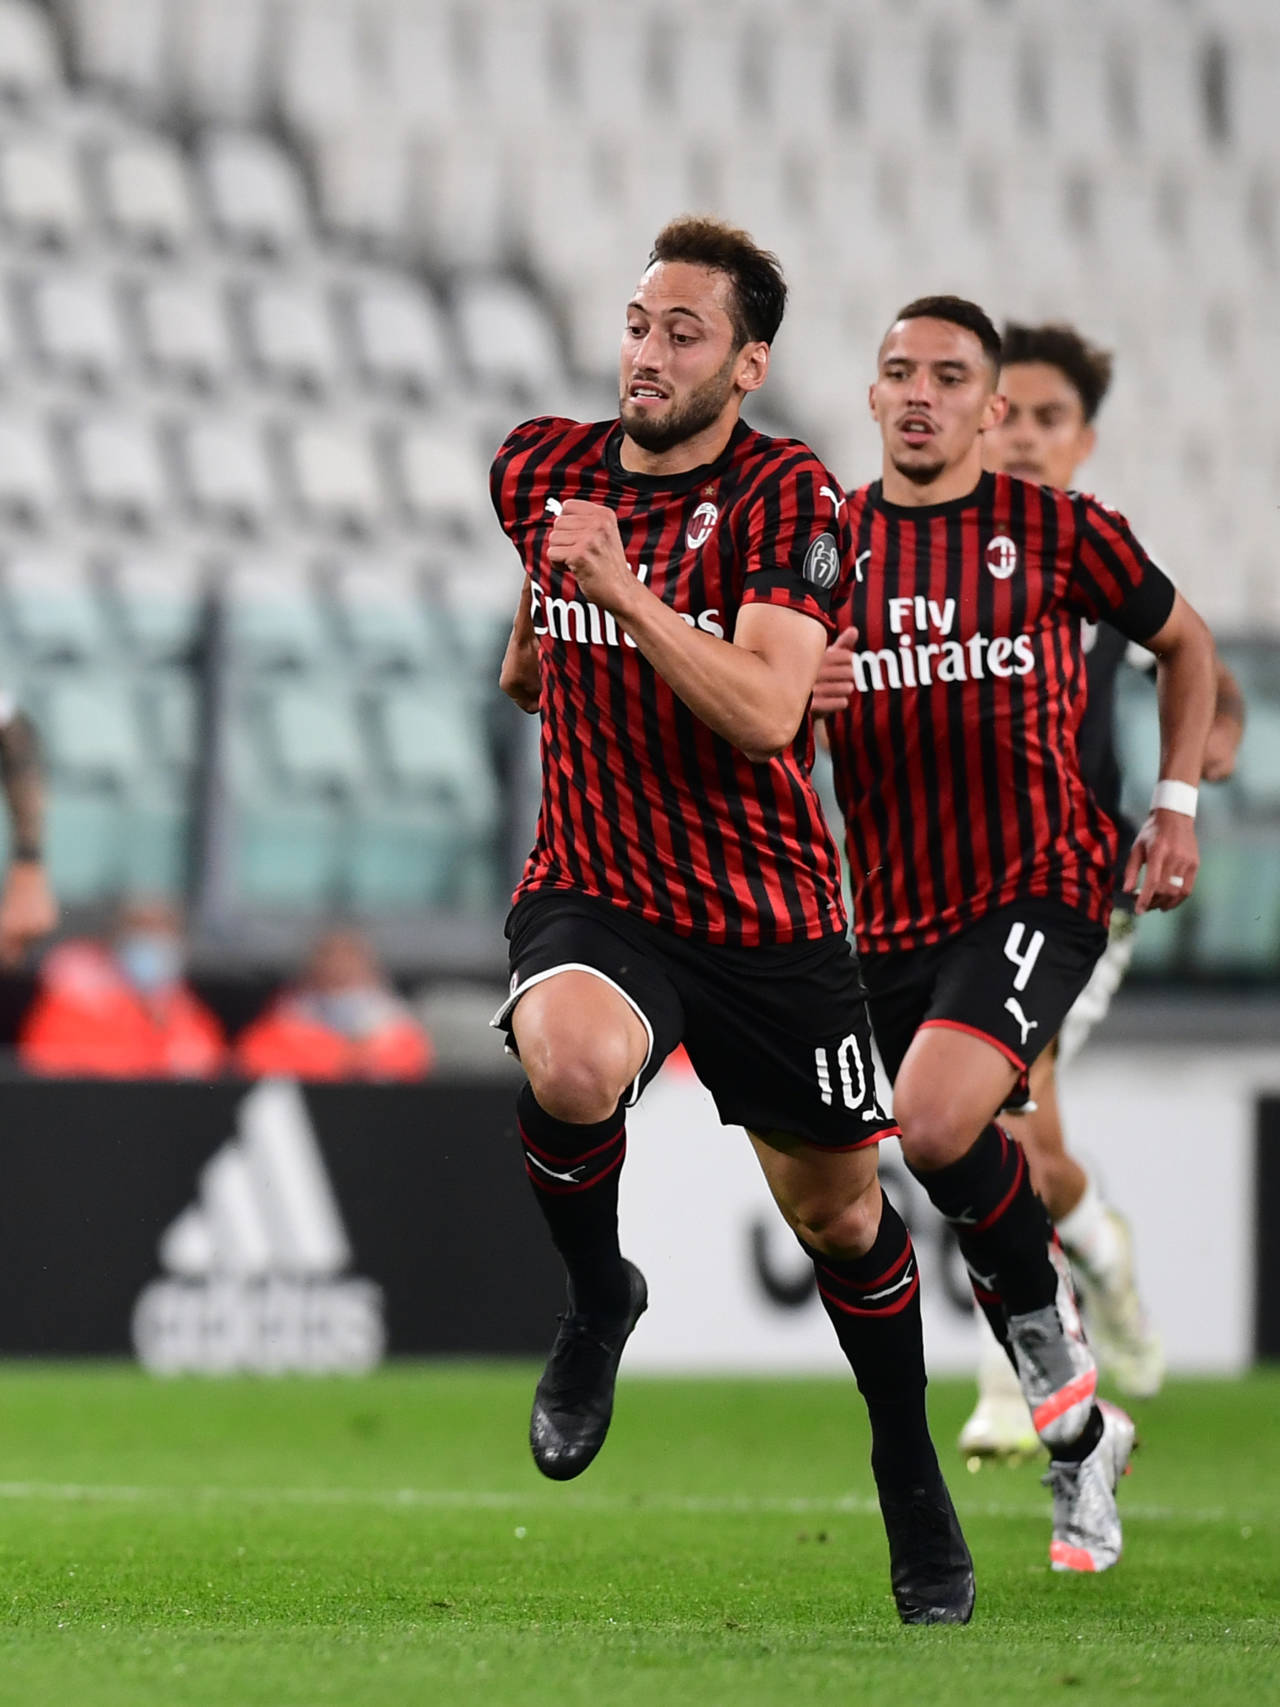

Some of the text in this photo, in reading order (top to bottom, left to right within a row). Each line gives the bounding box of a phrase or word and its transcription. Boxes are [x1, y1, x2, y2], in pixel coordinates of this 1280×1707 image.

[888, 595, 956, 635] Fly
[852, 631, 1035, 692] mirates
[1004, 922, 1045, 991] 4
[815, 1033, 867, 1110] 10
